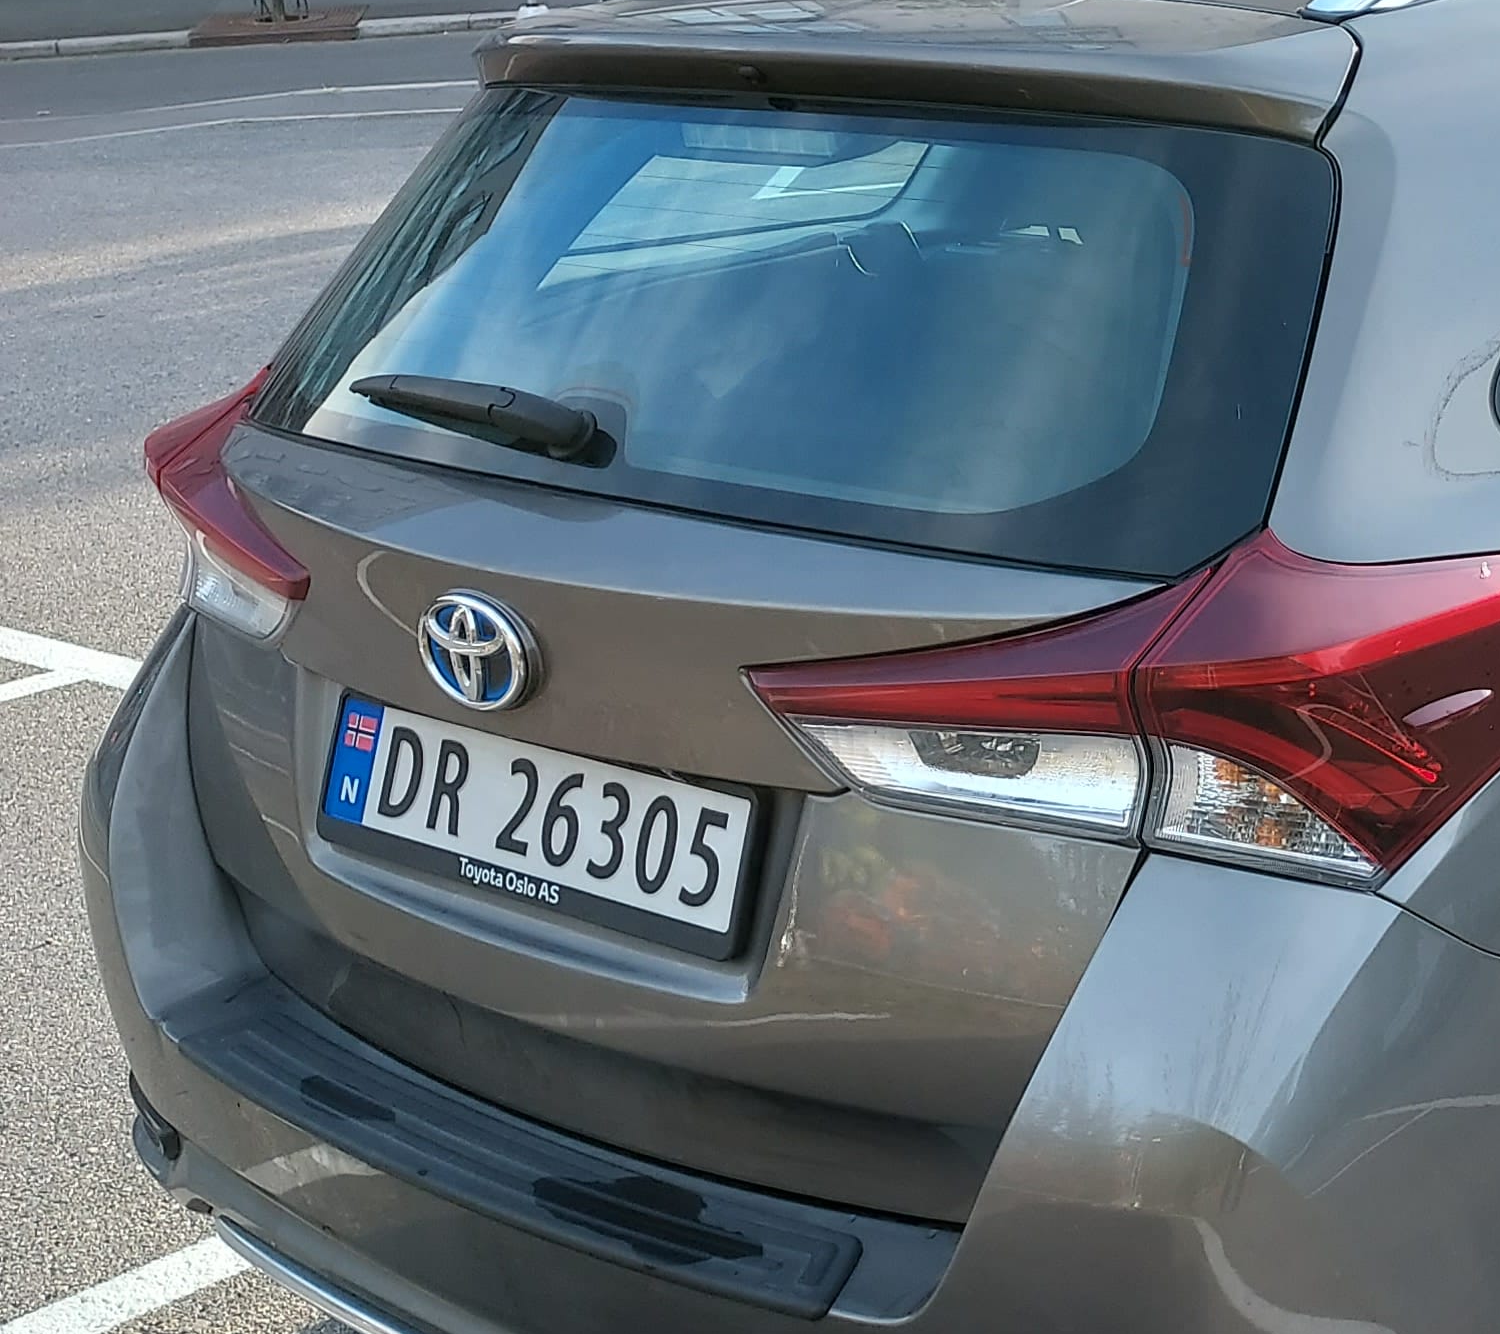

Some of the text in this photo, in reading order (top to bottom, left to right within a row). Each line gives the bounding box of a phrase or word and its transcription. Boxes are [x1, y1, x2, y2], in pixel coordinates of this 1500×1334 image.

[340, 775, 359, 804] N
[377, 726, 729, 907] DR 26305
[459, 857, 560, 904] Toyota Oslo AS
